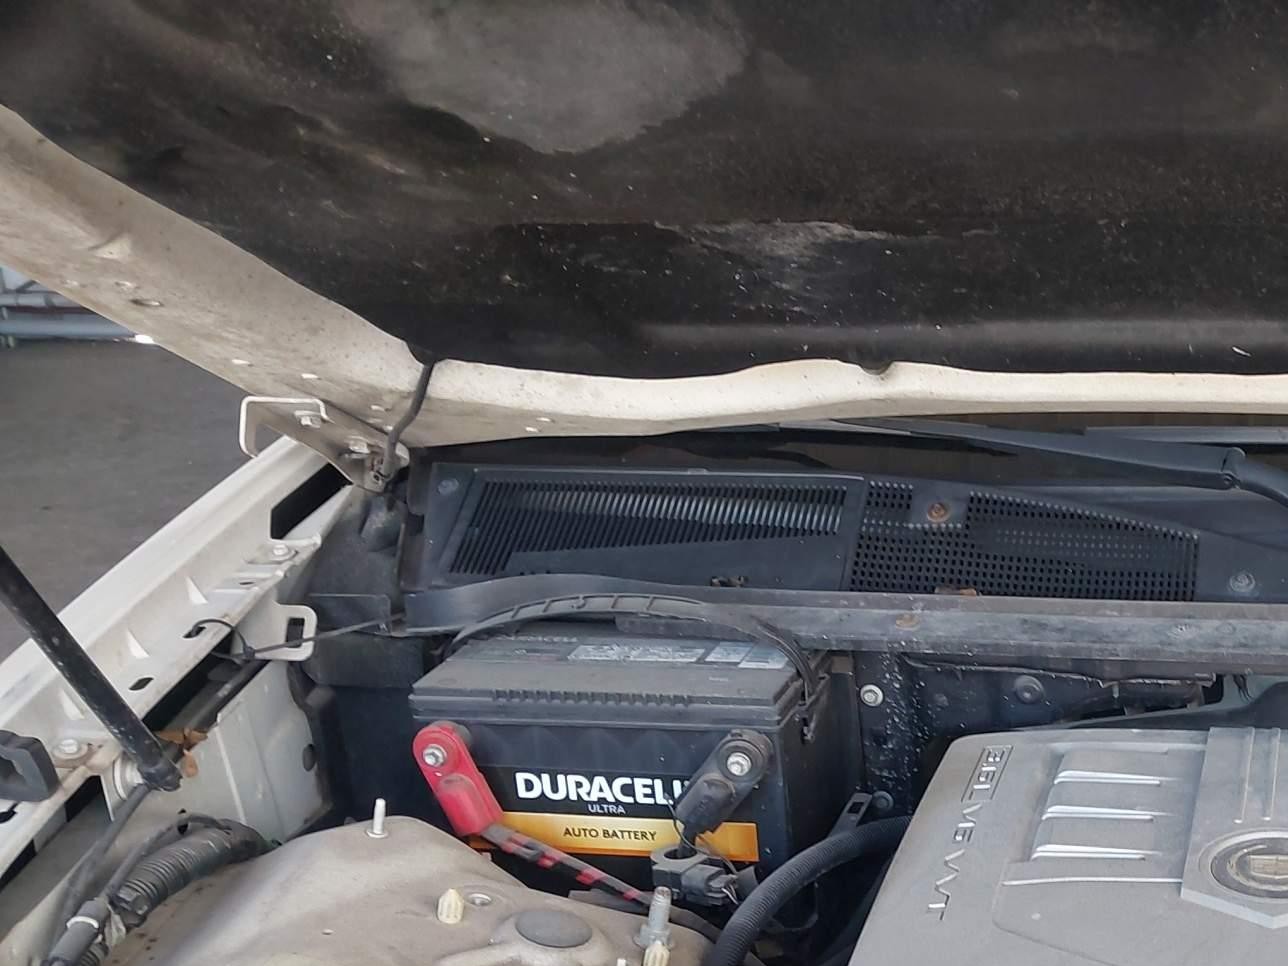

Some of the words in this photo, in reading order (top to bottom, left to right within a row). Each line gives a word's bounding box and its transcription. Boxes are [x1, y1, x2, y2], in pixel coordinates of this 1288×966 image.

[968, 748, 1006, 800] 3.6L
[587, 803, 626, 815] ULTRA
[953, 803, 982, 843] V6
[563, 826, 599, 838] AUTO
[602, 829, 657, 841] BATTERY
[927, 848, 966, 921] VVT
